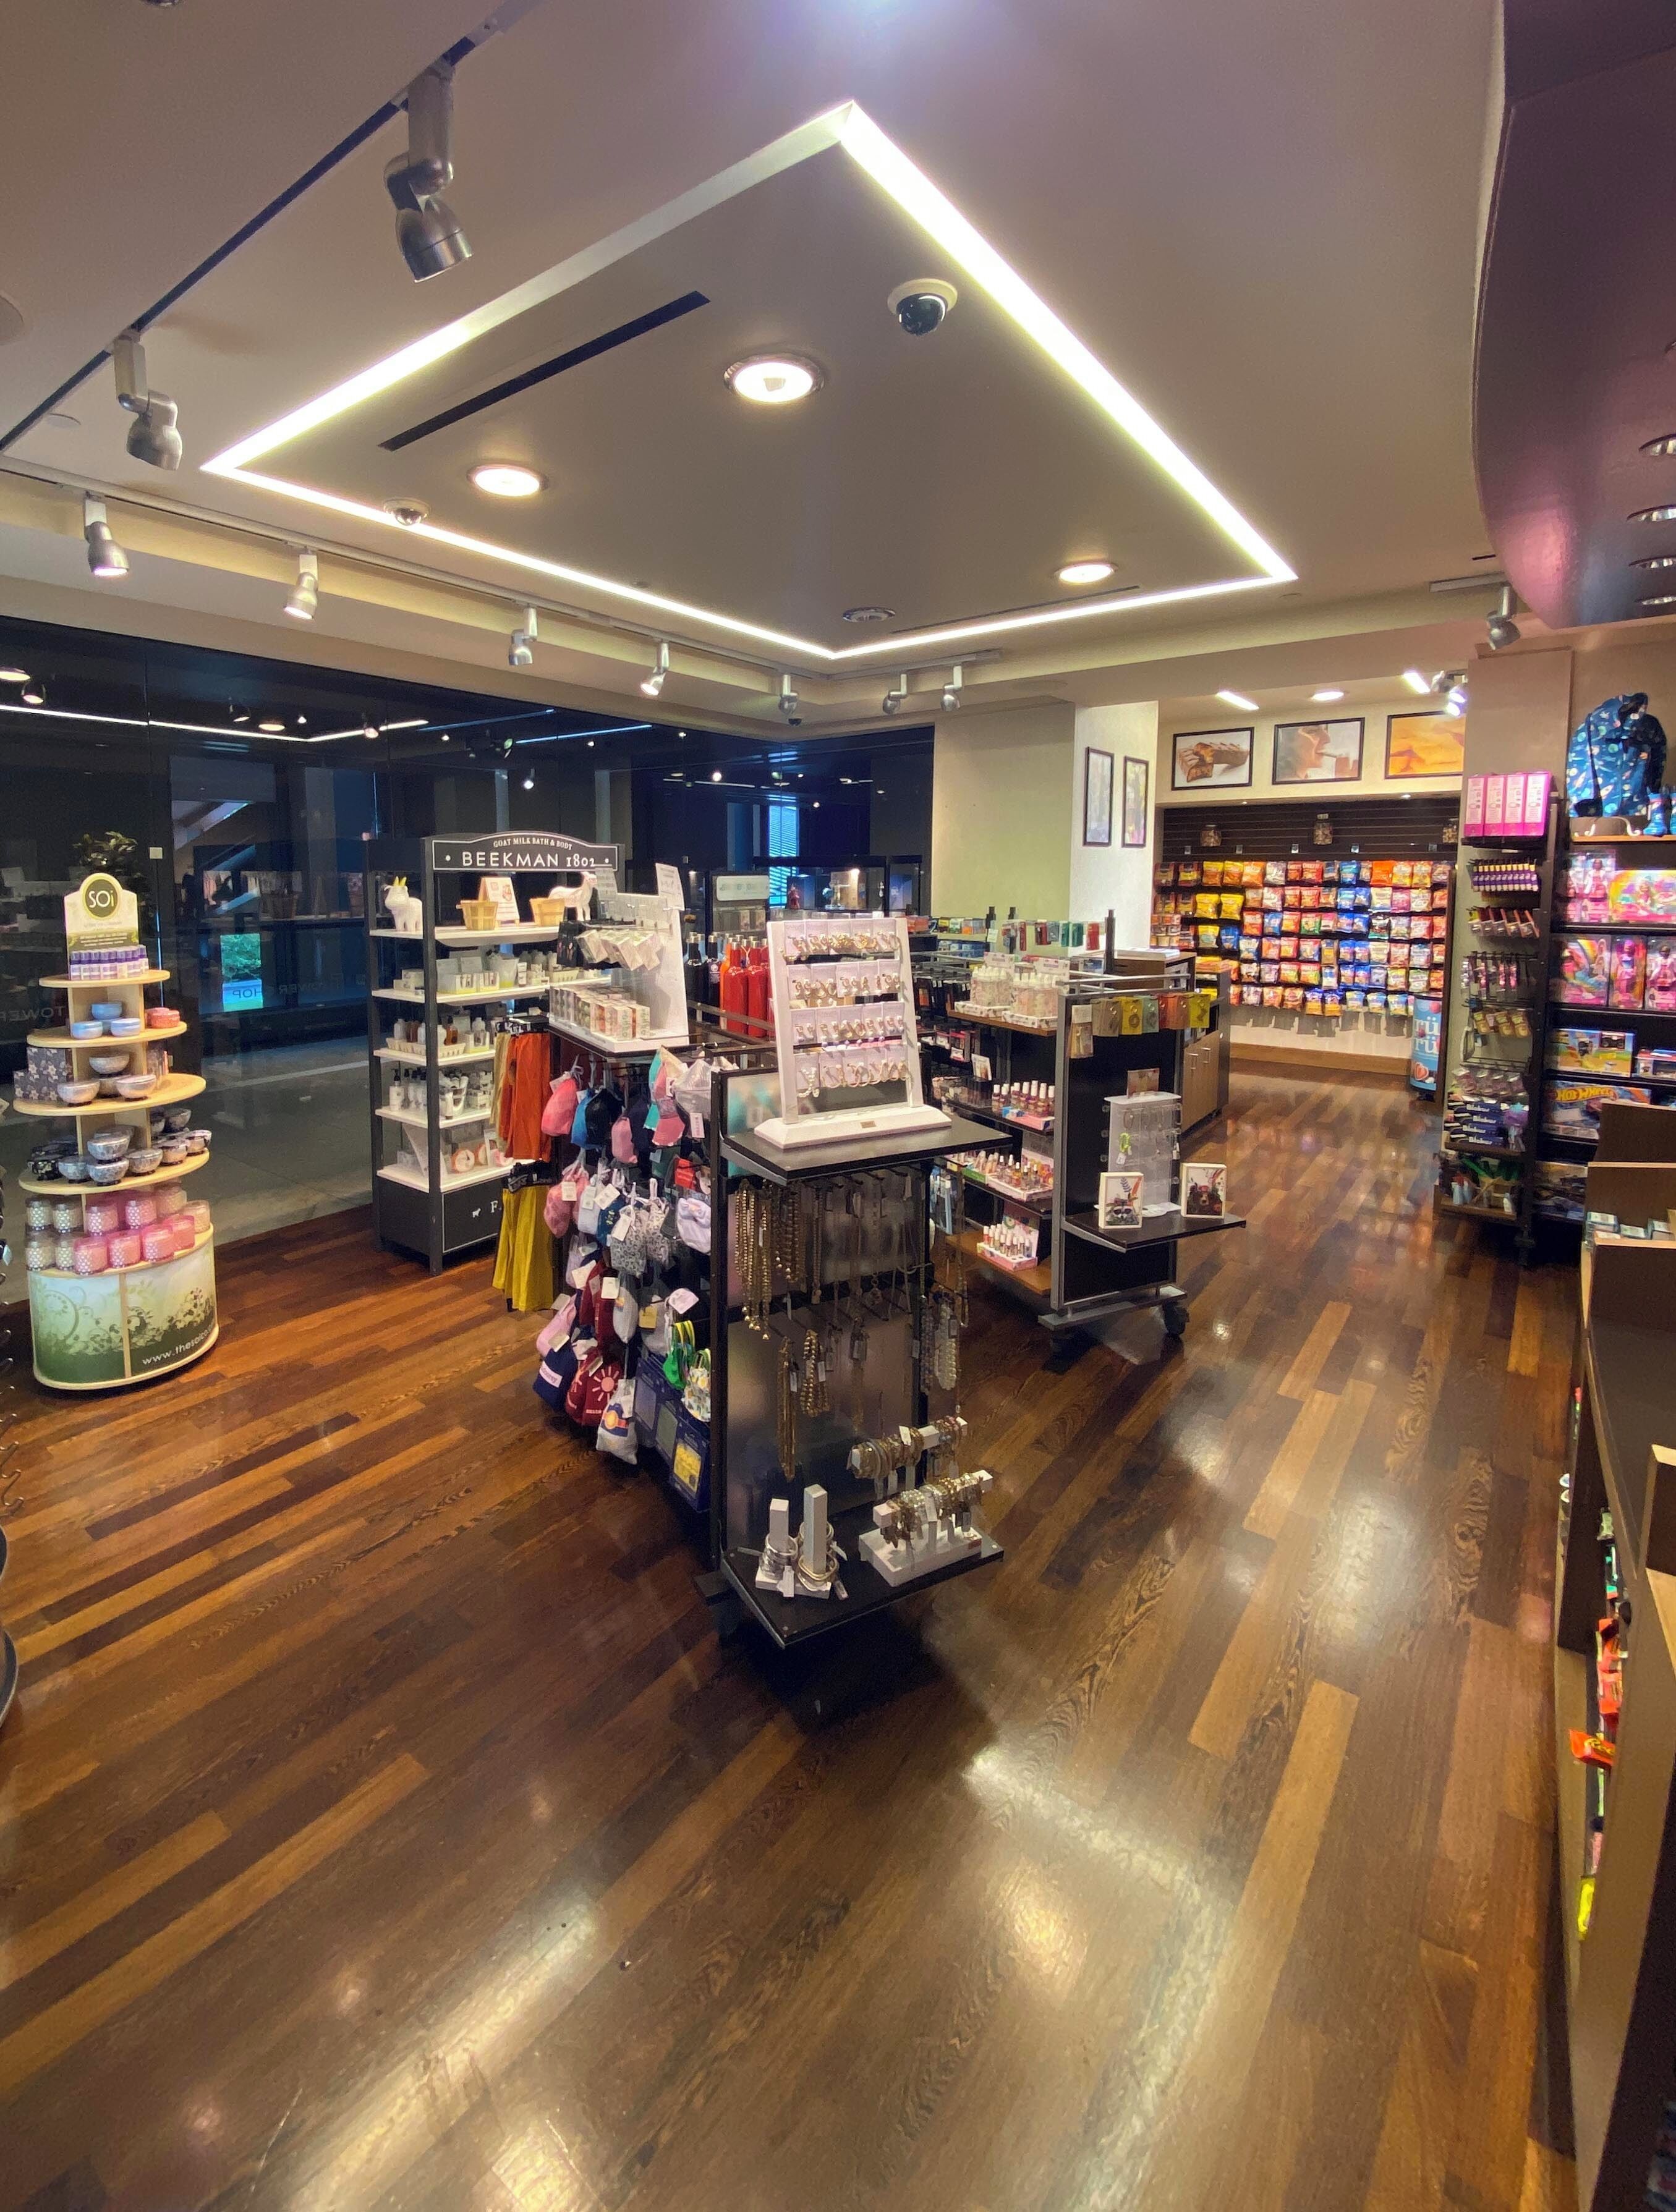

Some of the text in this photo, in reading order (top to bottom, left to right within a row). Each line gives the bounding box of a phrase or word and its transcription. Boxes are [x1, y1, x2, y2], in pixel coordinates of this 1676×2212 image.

[493, 839, 511, 848] GOAT
[513, 837, 530, 845] MILK
[556, 841, 572, 850] BODY
[462, 852, 595, 867] BEEKMAN 1802
